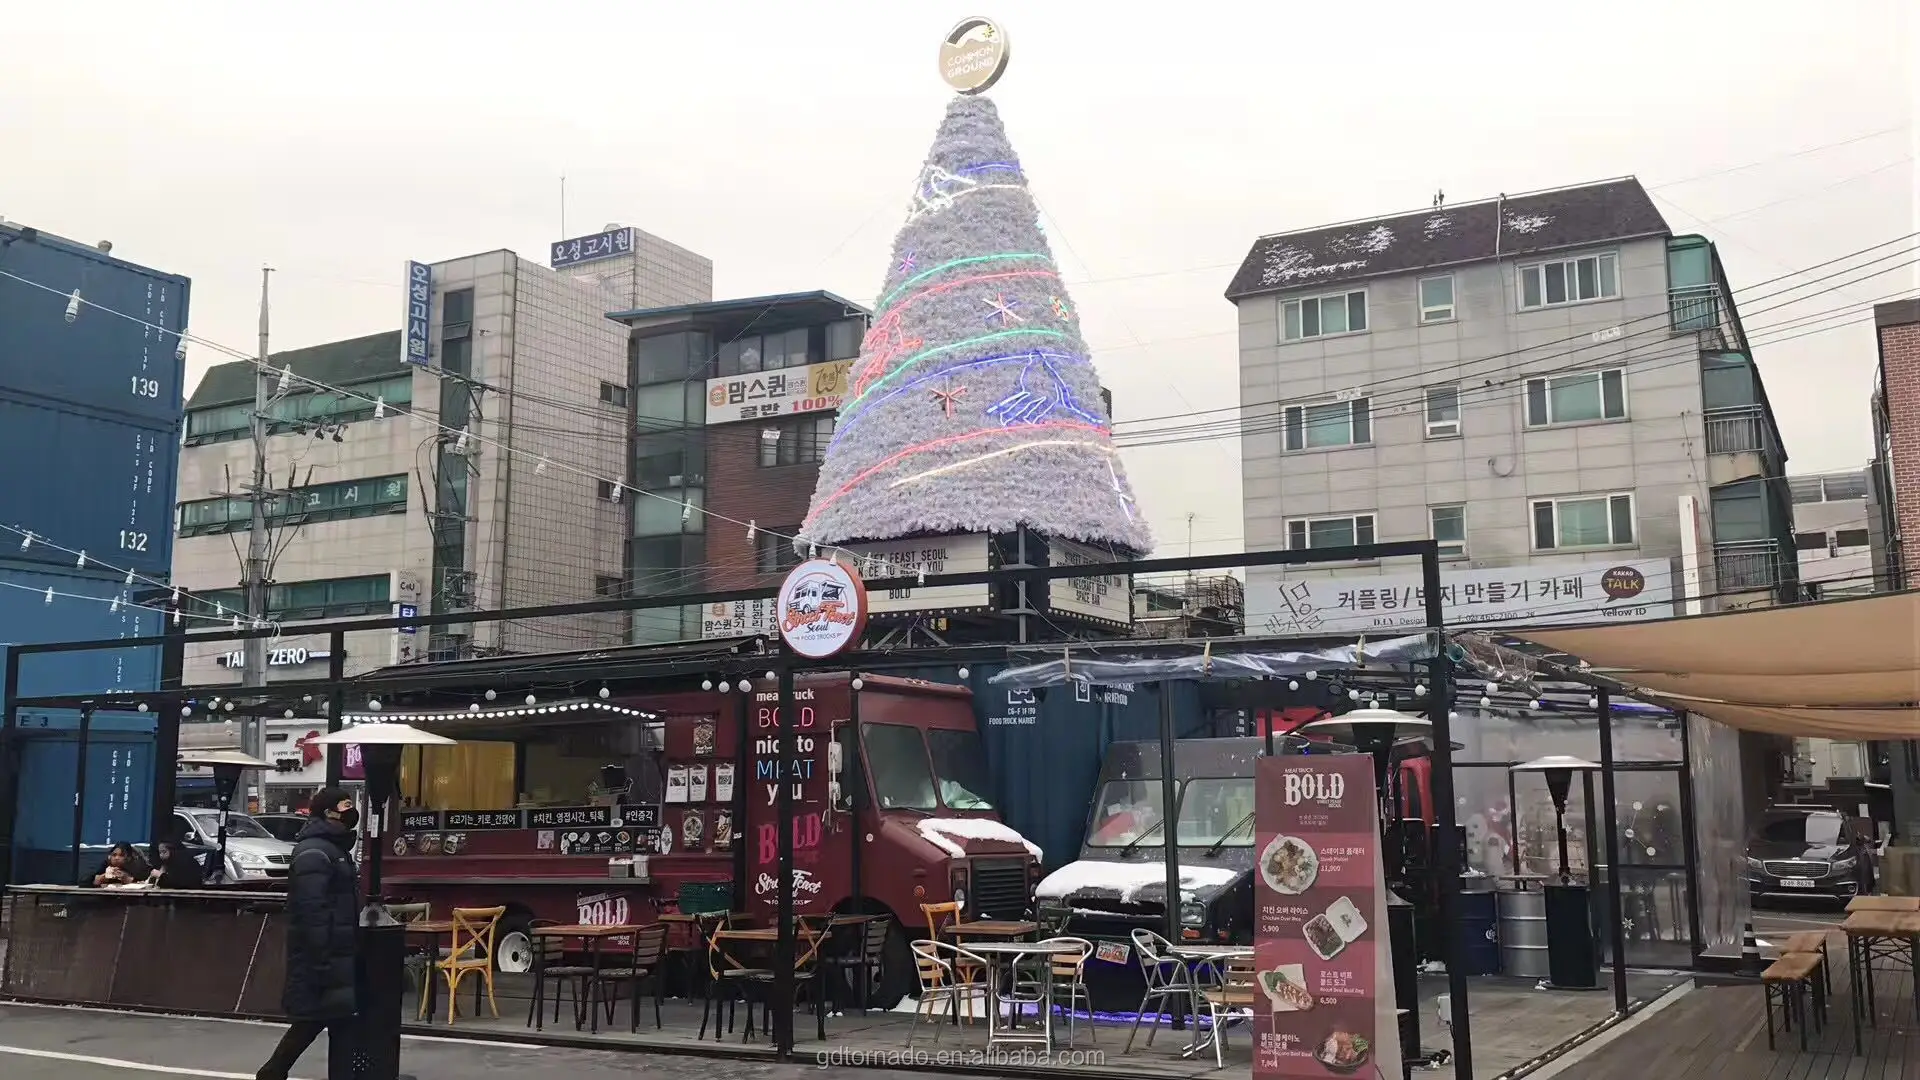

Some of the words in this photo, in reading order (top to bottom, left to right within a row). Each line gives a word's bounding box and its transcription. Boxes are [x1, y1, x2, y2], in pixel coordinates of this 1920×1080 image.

[553, 230, 629, 262] 오성고시원
[409, 265, 428, 356] 오성고시원
[131, 375, 159, 398] 139
[728, 374, 787, 405] 맘스퀸
[120, 530, 148, 552] 132
[889, 551, 916, 564] FEAST
[921, 548, 949, 561] SEOUL
[858, 565, 879, 578] NCE
[927, 560, 944, 573] YOU
[1612, 569, 1634, 577] KAKAO
[1464, 580, 1528, 604] 만들기
[1539, 576, 1583, 600] 카페
[1606, 577, 1640, 590] TALK
[889, 588, 911, 600] BOLD
[1601, 608, 1632, 618] Yellow
[1635, 607, 1648, 617] ID
[804, 622, 829, 633] Seoul
[1399, 617, 1425, 628] Design
[270, 647, 306, 665] ZERO
[758, 706, 814, 728] BOD
[797, 735, 815, 753] to
[766, 783, 803, 806] yu
[1282, 772, 1345, 807] BOLD
[758, 813, 822, 865] BLD
[1320, 847, 1345, 856] 스테이크
[1262, 906, 1275, 914] 치킨
[1276, 906, 1289, 915] 오버
[1290, 907, 1309, 915] 라이스
[1320, 997, 1337, 1005] 6,500
